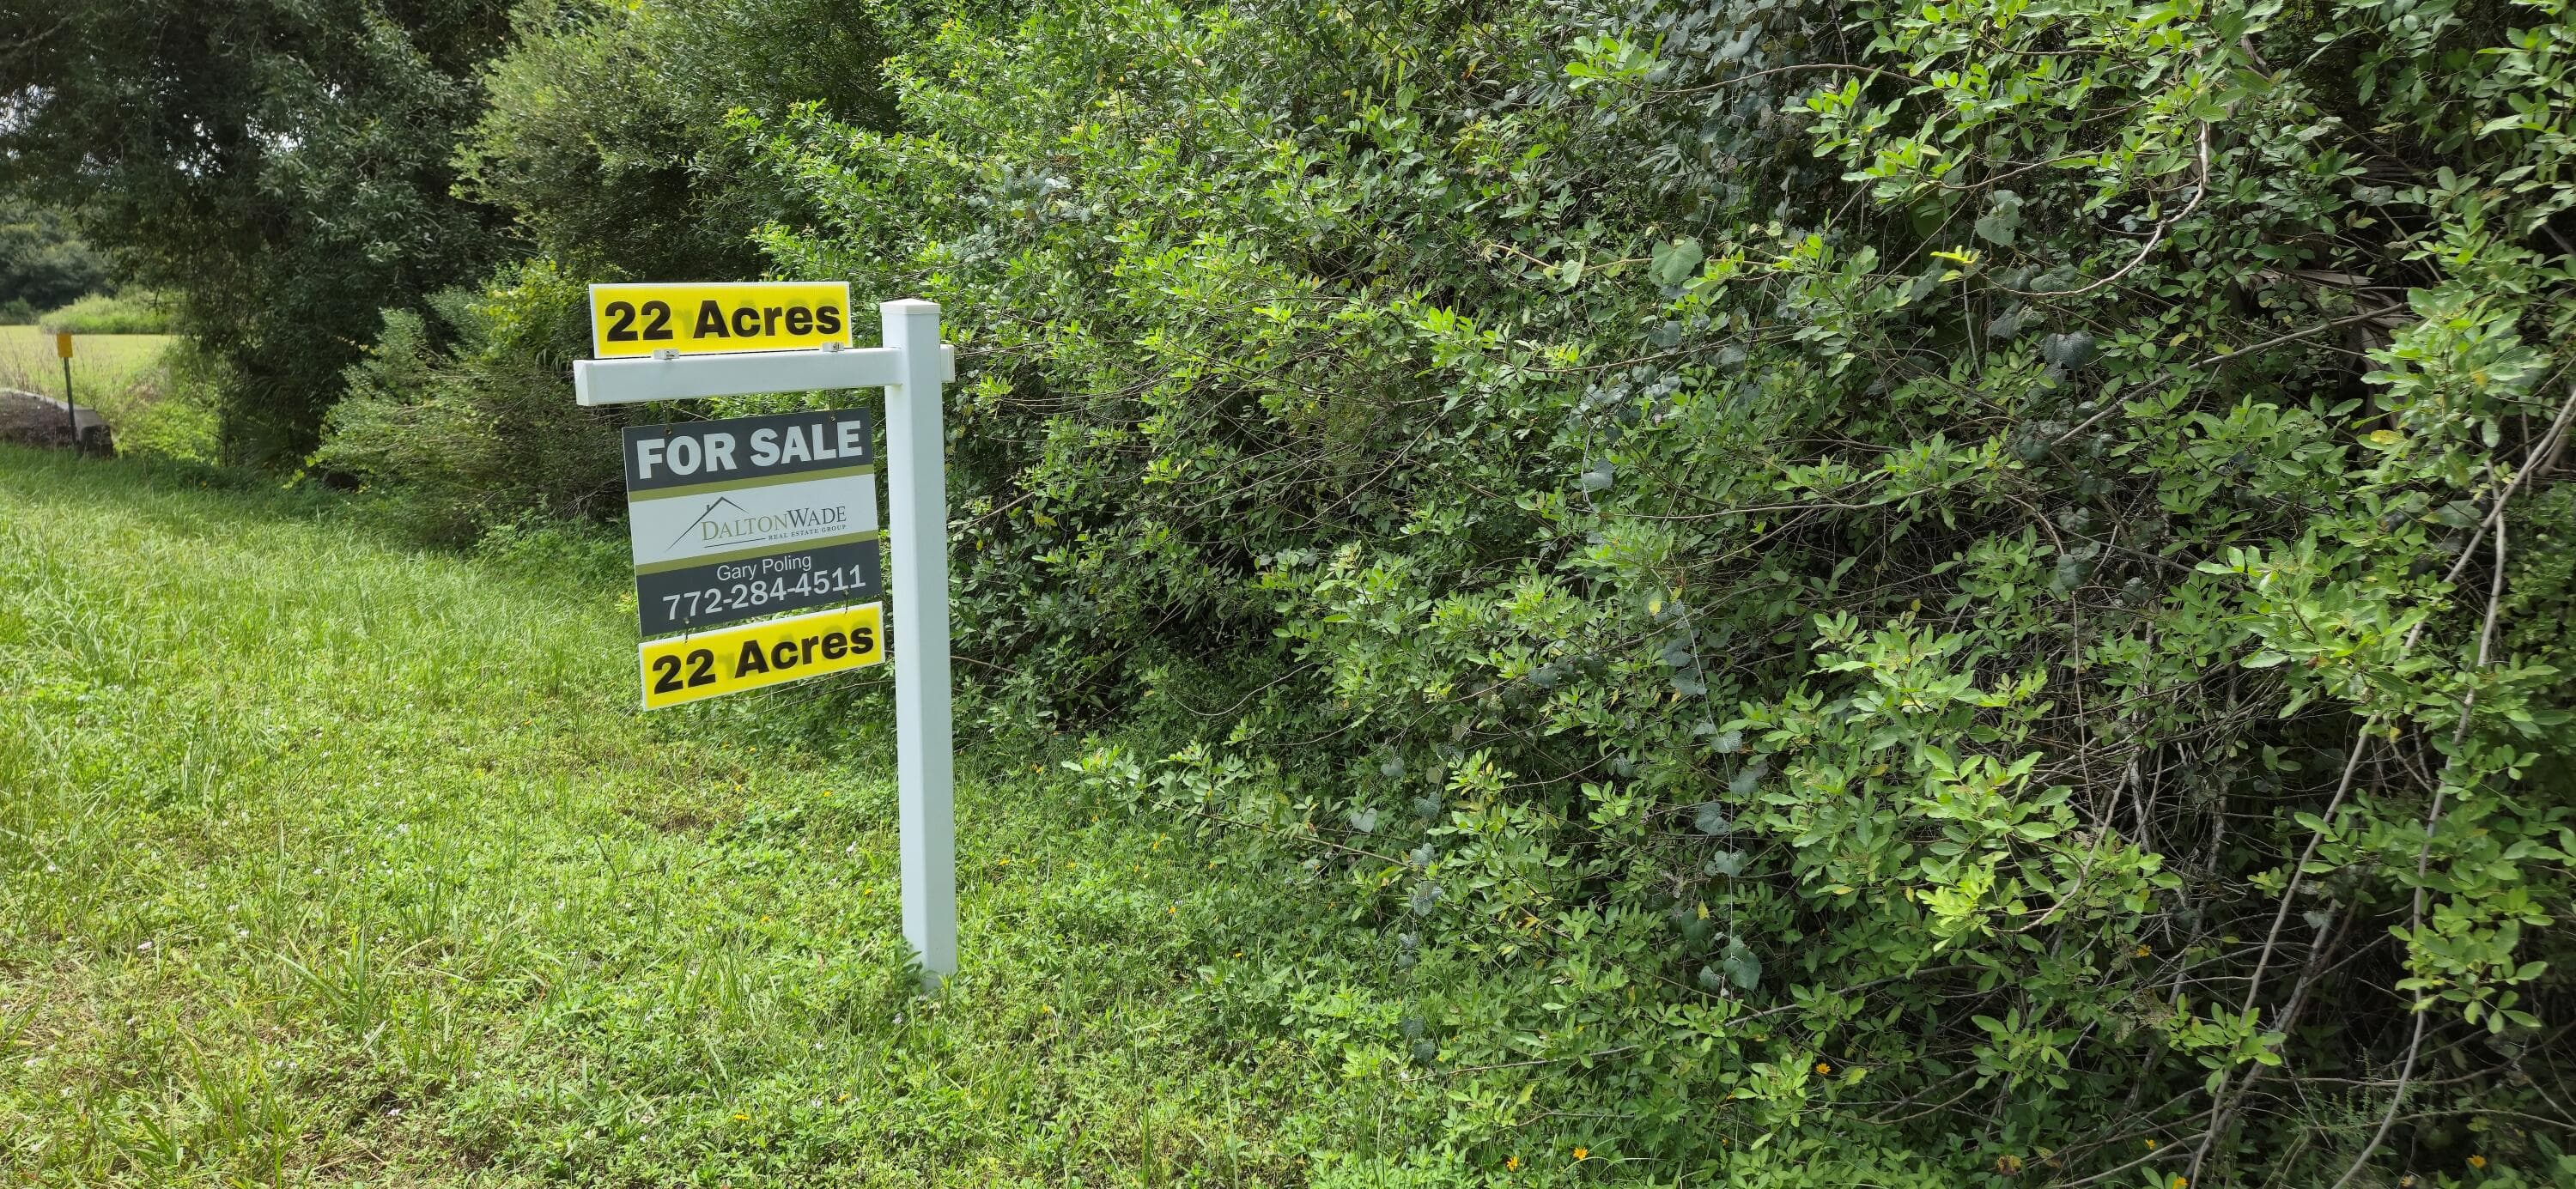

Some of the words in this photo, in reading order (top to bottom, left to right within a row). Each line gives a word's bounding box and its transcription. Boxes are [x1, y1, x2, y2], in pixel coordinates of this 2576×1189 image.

[605, 300, 673, 342] 22
[693, 300, 841, 339] Acres
[637, 432, 738, 480] FOR
[750, 420, 863, 467] SALE
[791, 529, 819, 538] ESTATE
[822, 524, 847, 533] GROUP
[663, 564, 866, 621] 772-284-4511
[717, 565, 756, 582] Gary
[762, 555, 811, 573] Poling
[652, 649, 716, 695] 22
[734, 627, 874, 678] Acres
